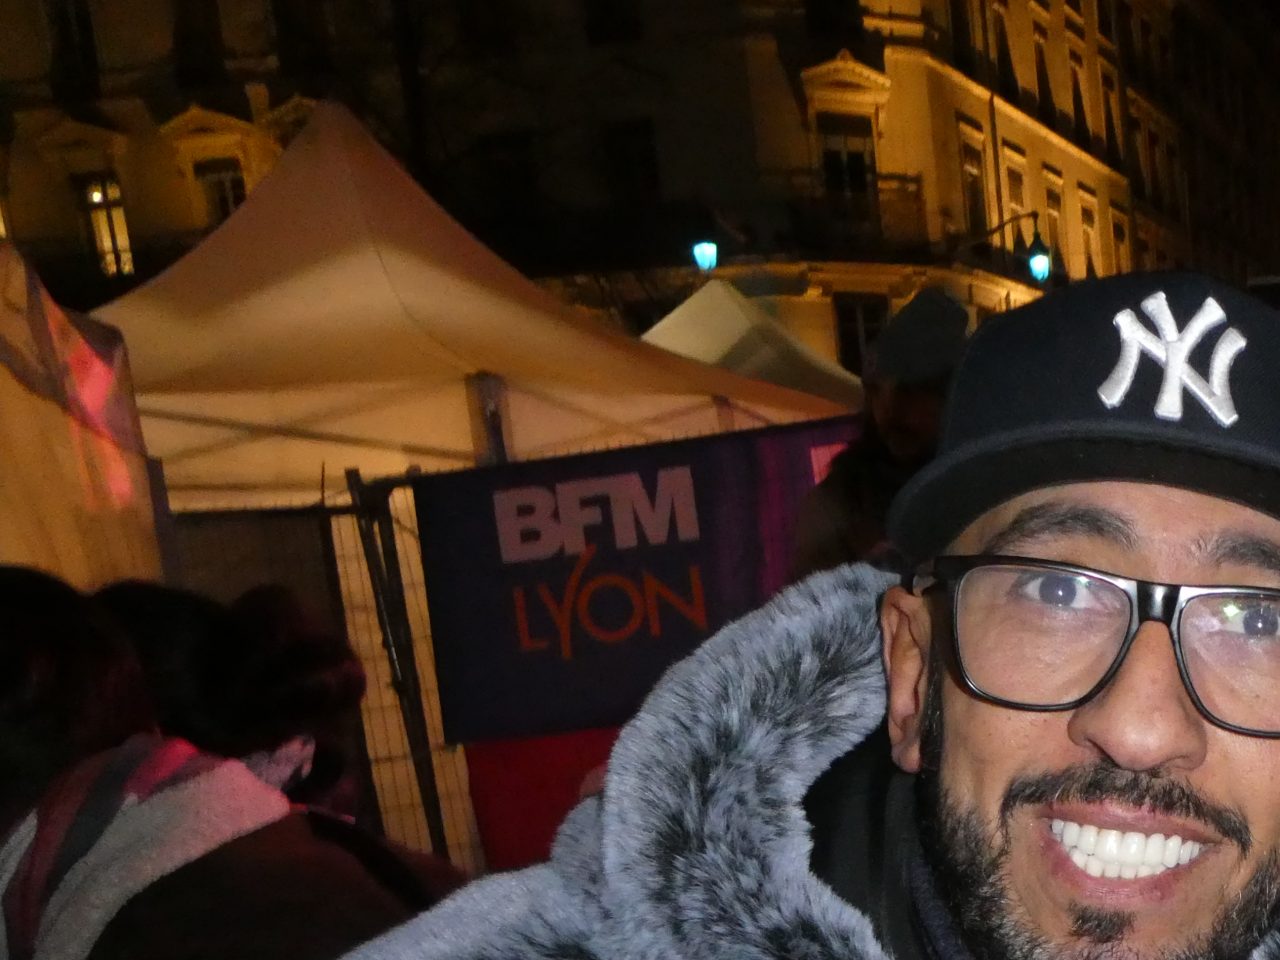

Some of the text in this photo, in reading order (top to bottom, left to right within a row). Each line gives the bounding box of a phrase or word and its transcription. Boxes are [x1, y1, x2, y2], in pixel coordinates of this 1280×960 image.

[1097, 290, 1248, 428] NY
[493, 465, 700, 564] BFM
[512, 544, 709, 660] LYON
